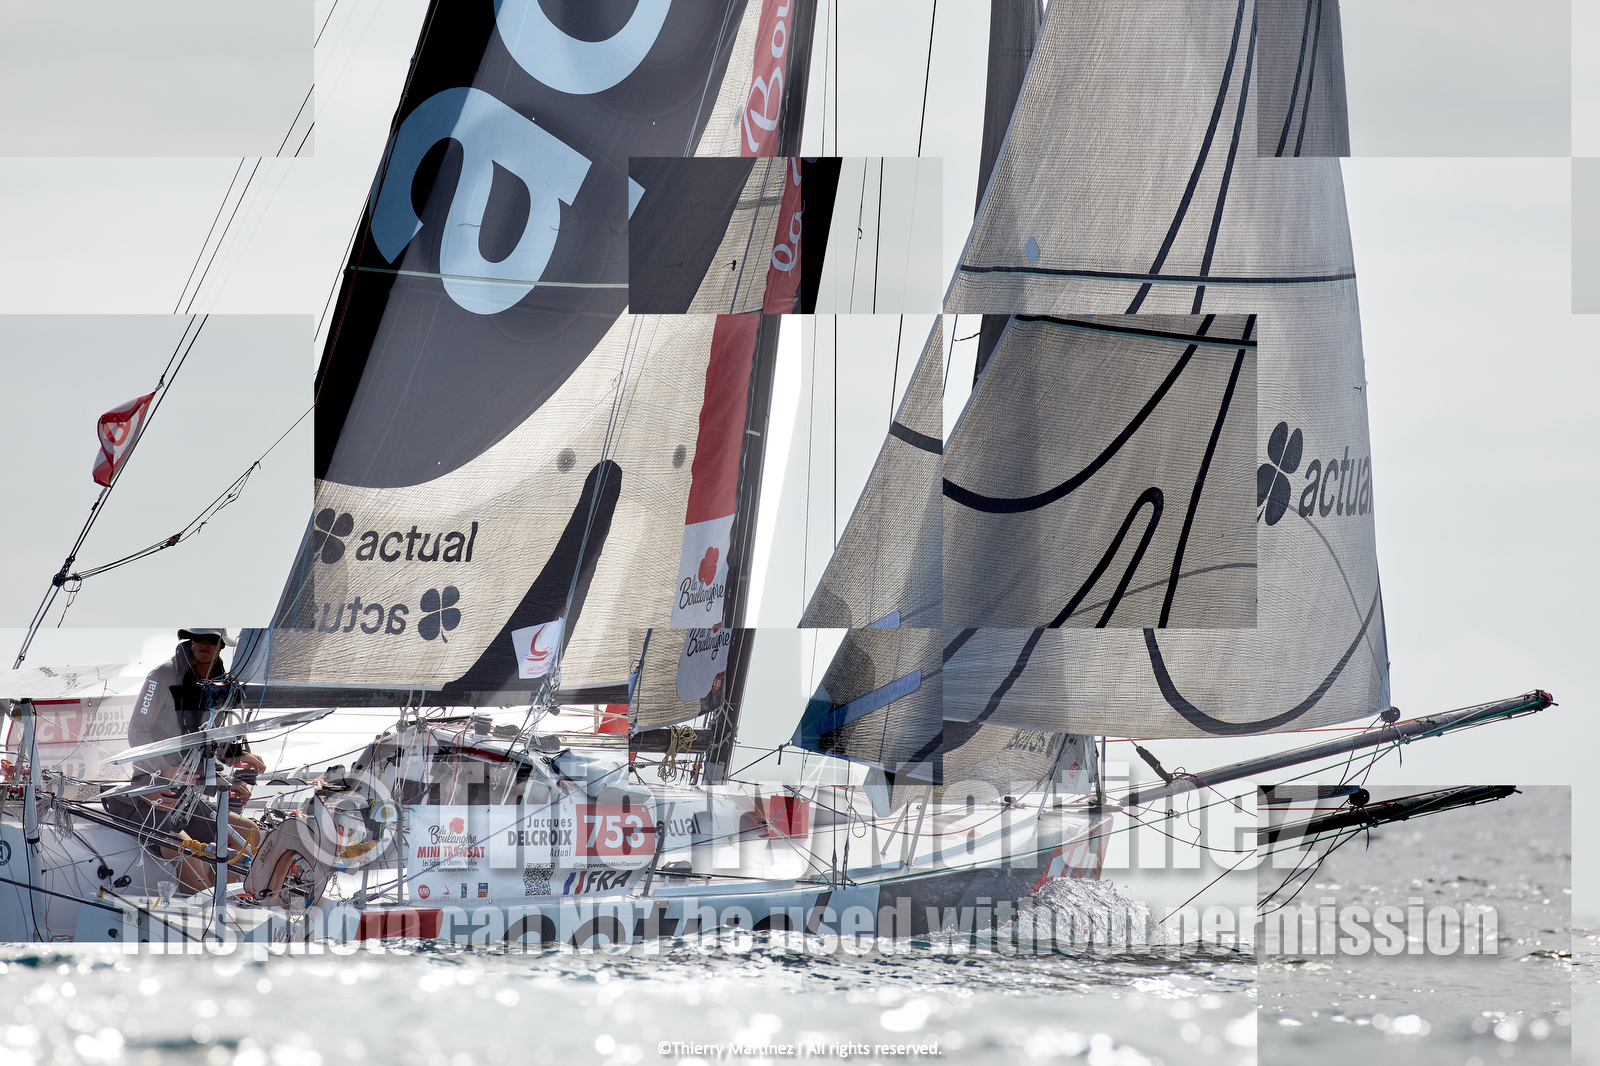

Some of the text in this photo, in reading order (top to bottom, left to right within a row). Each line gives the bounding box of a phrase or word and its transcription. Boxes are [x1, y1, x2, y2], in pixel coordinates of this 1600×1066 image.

[356, 522, 478, 562] actual
[140, 680, 157, 715] actual
[527, 815, 572, 831] Jacques
[583, 815, 645, 848] 753
[428, 825, 477, 850] Boulangère
[507, 830, 572, 846] DELCROIX
[417, 846, 485, 858] MINI TRANSAT
[550, 847, 571, 857] Actual
[584, 870, 633, 893] FRA
